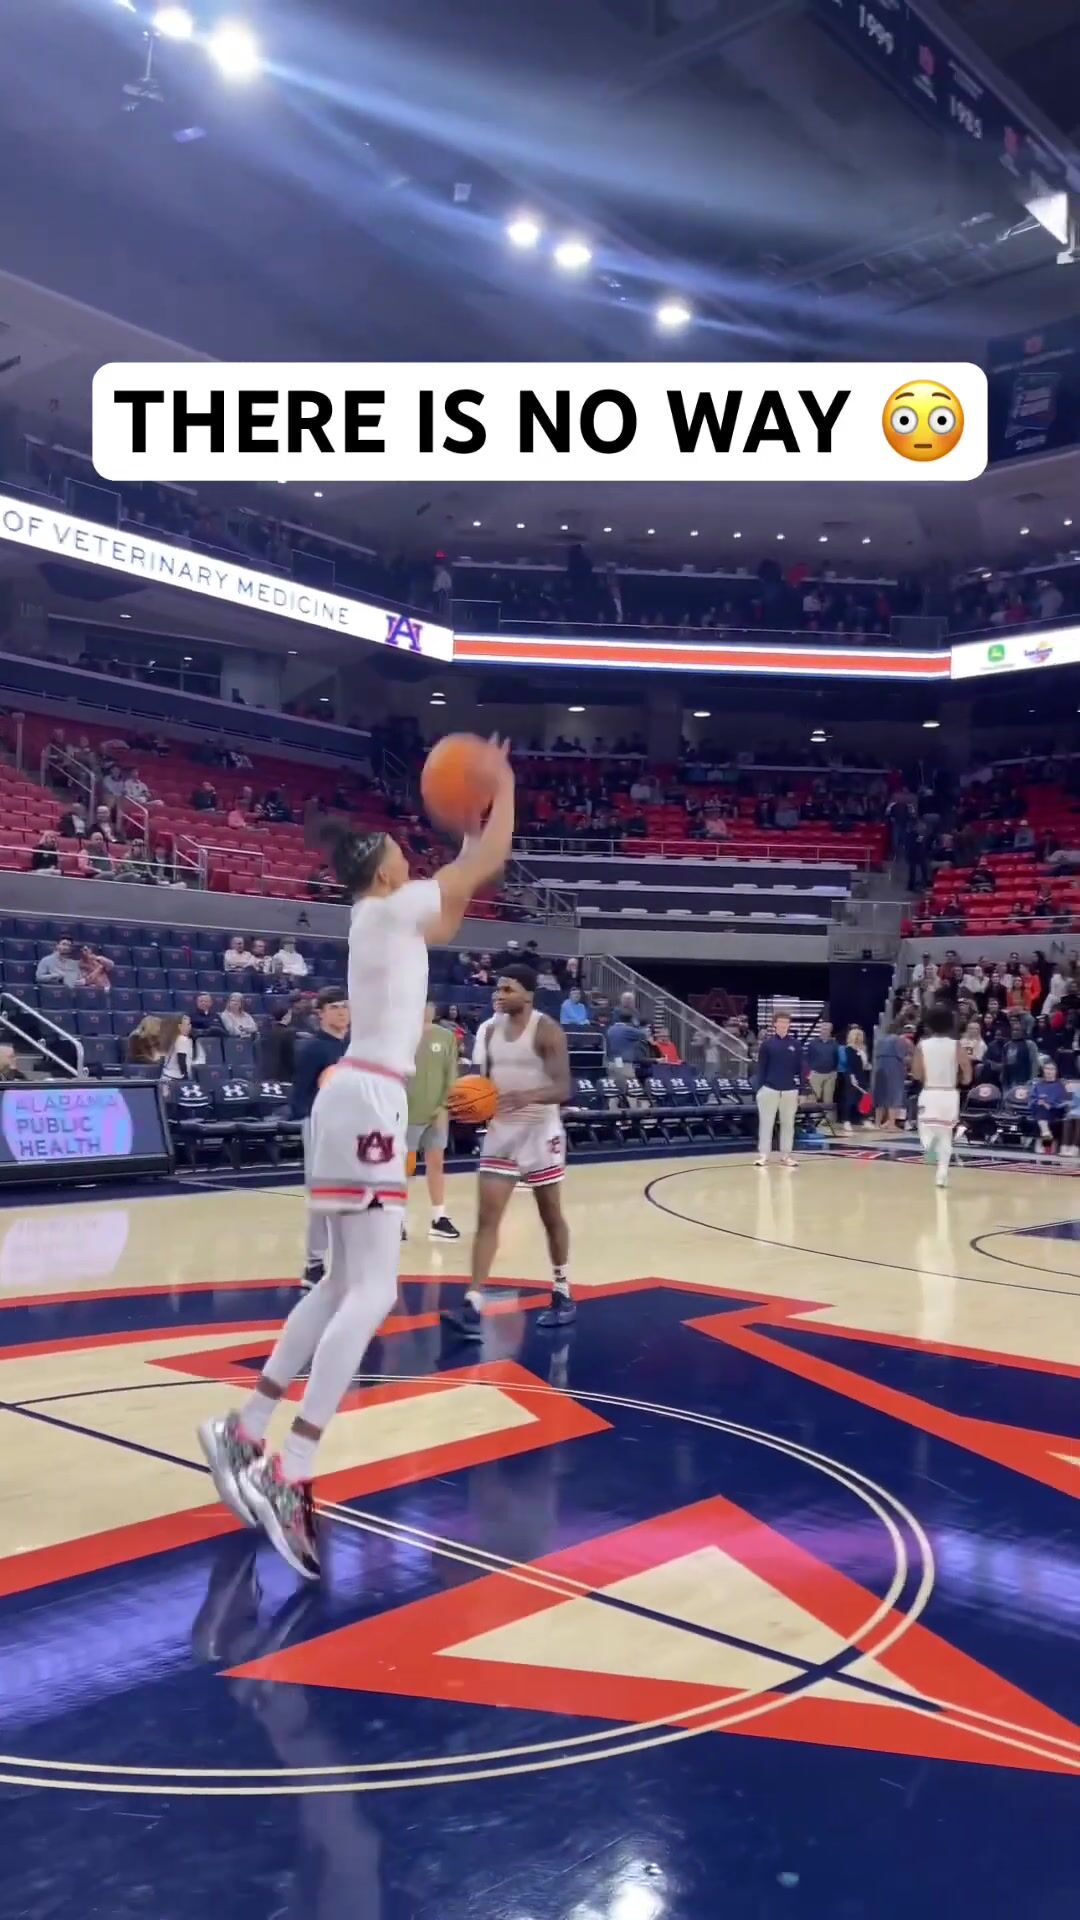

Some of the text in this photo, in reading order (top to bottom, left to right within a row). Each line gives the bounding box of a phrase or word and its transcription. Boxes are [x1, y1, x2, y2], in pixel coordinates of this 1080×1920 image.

[3, 509, 350, 626] OF VETERINARY MEDICINE
[16, 1116, 94, 1134] PUBLIC
[19, 1136, 101, 1157] HEALTH
